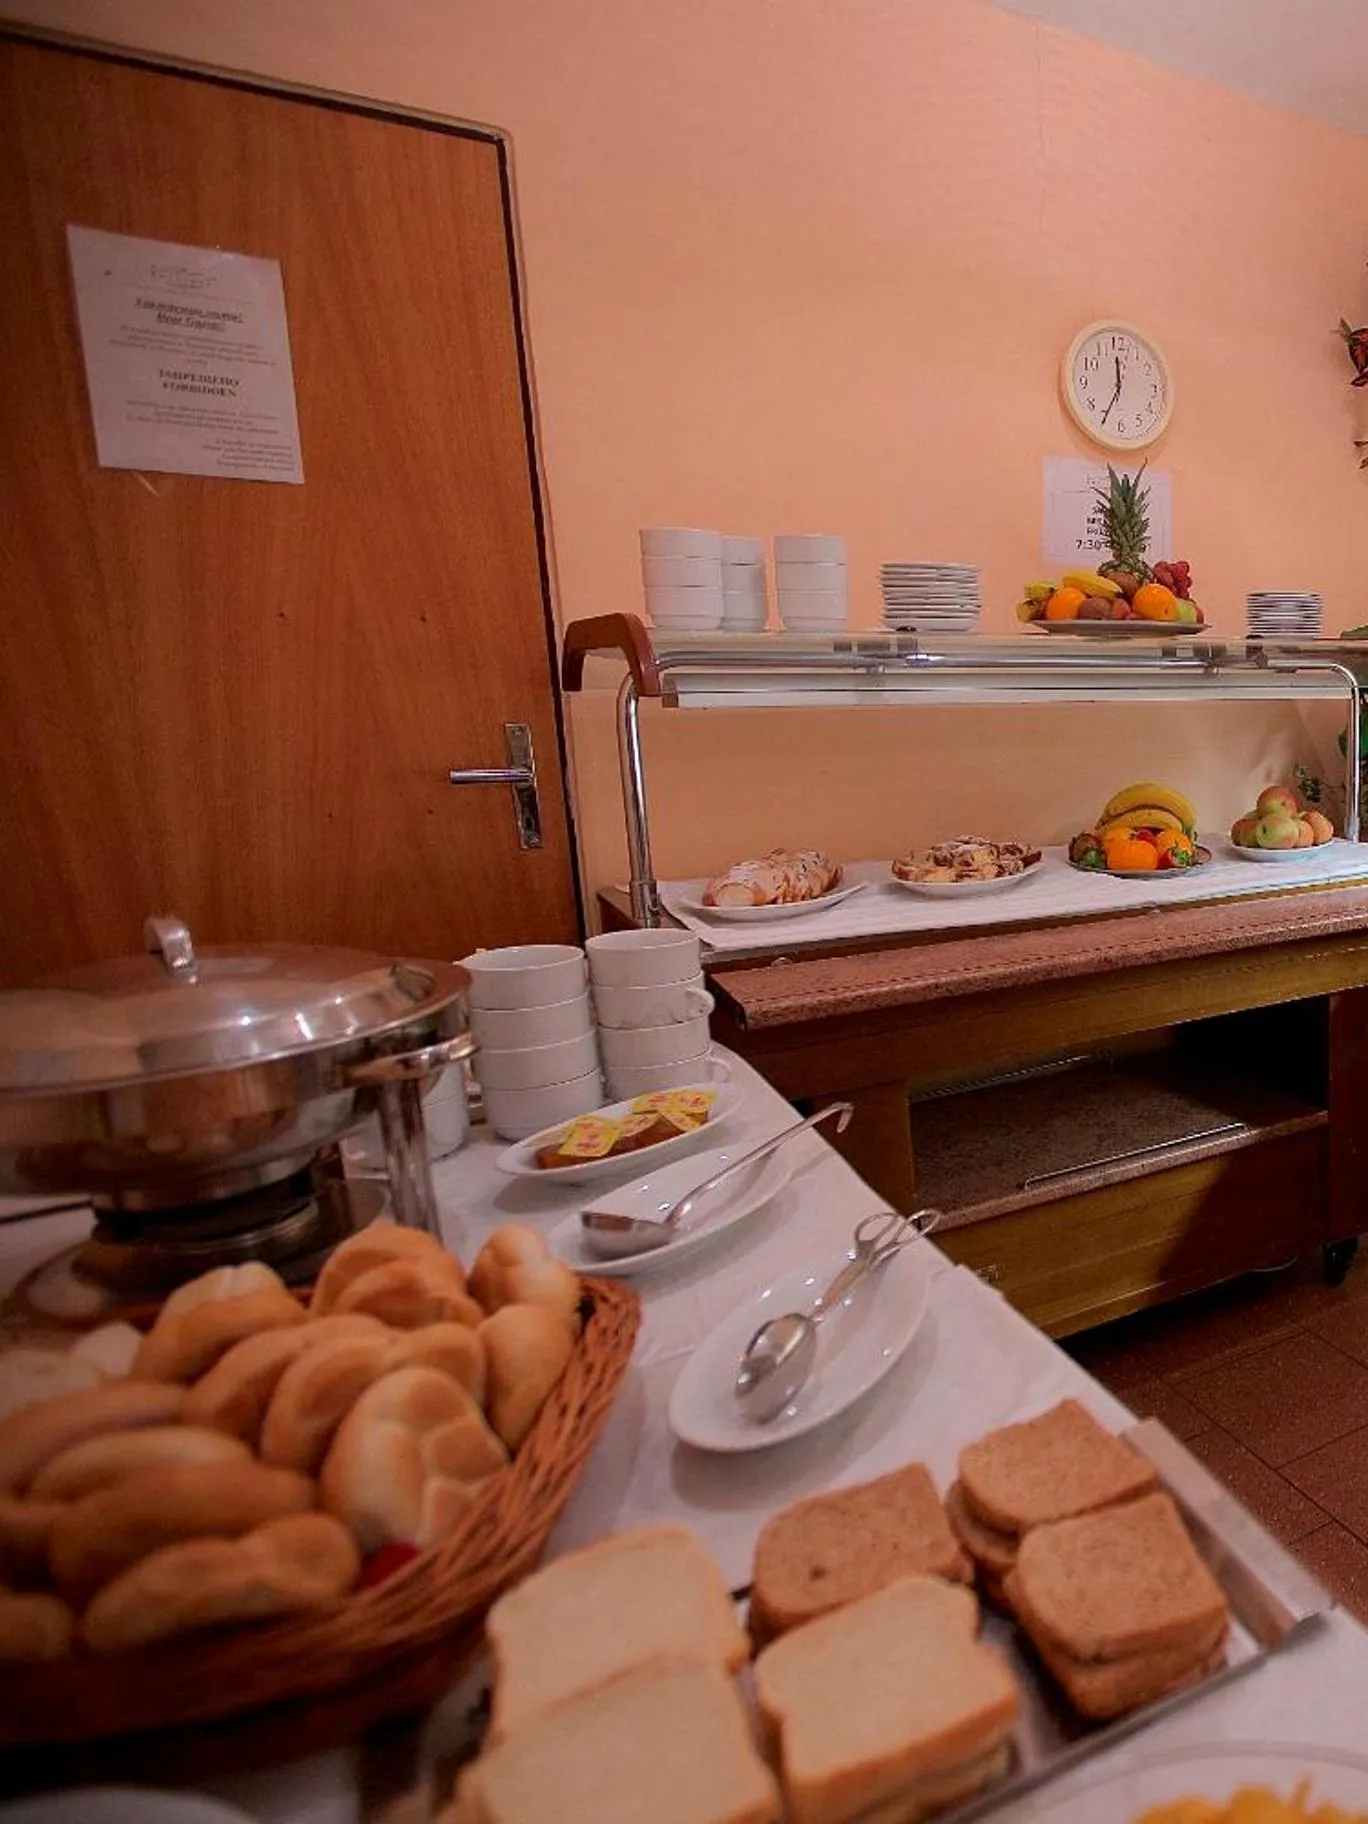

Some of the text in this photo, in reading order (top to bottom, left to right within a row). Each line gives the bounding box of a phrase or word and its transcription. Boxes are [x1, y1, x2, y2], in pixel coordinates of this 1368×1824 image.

[1096, 341, 1109, 356] 11
[1111, 336, 1126, 351] 12
[1084, 356, 1099, 371] 10
[1143, 362, 1152, 376] 2
[1079, 375, 1088, 389] 9
[1151, 383, 1158, 398] 3
[1086, 396, 1096, 410] 8
[1117, 419, 1126, 433] 6
[1135, 413, 1143, 427] 5
